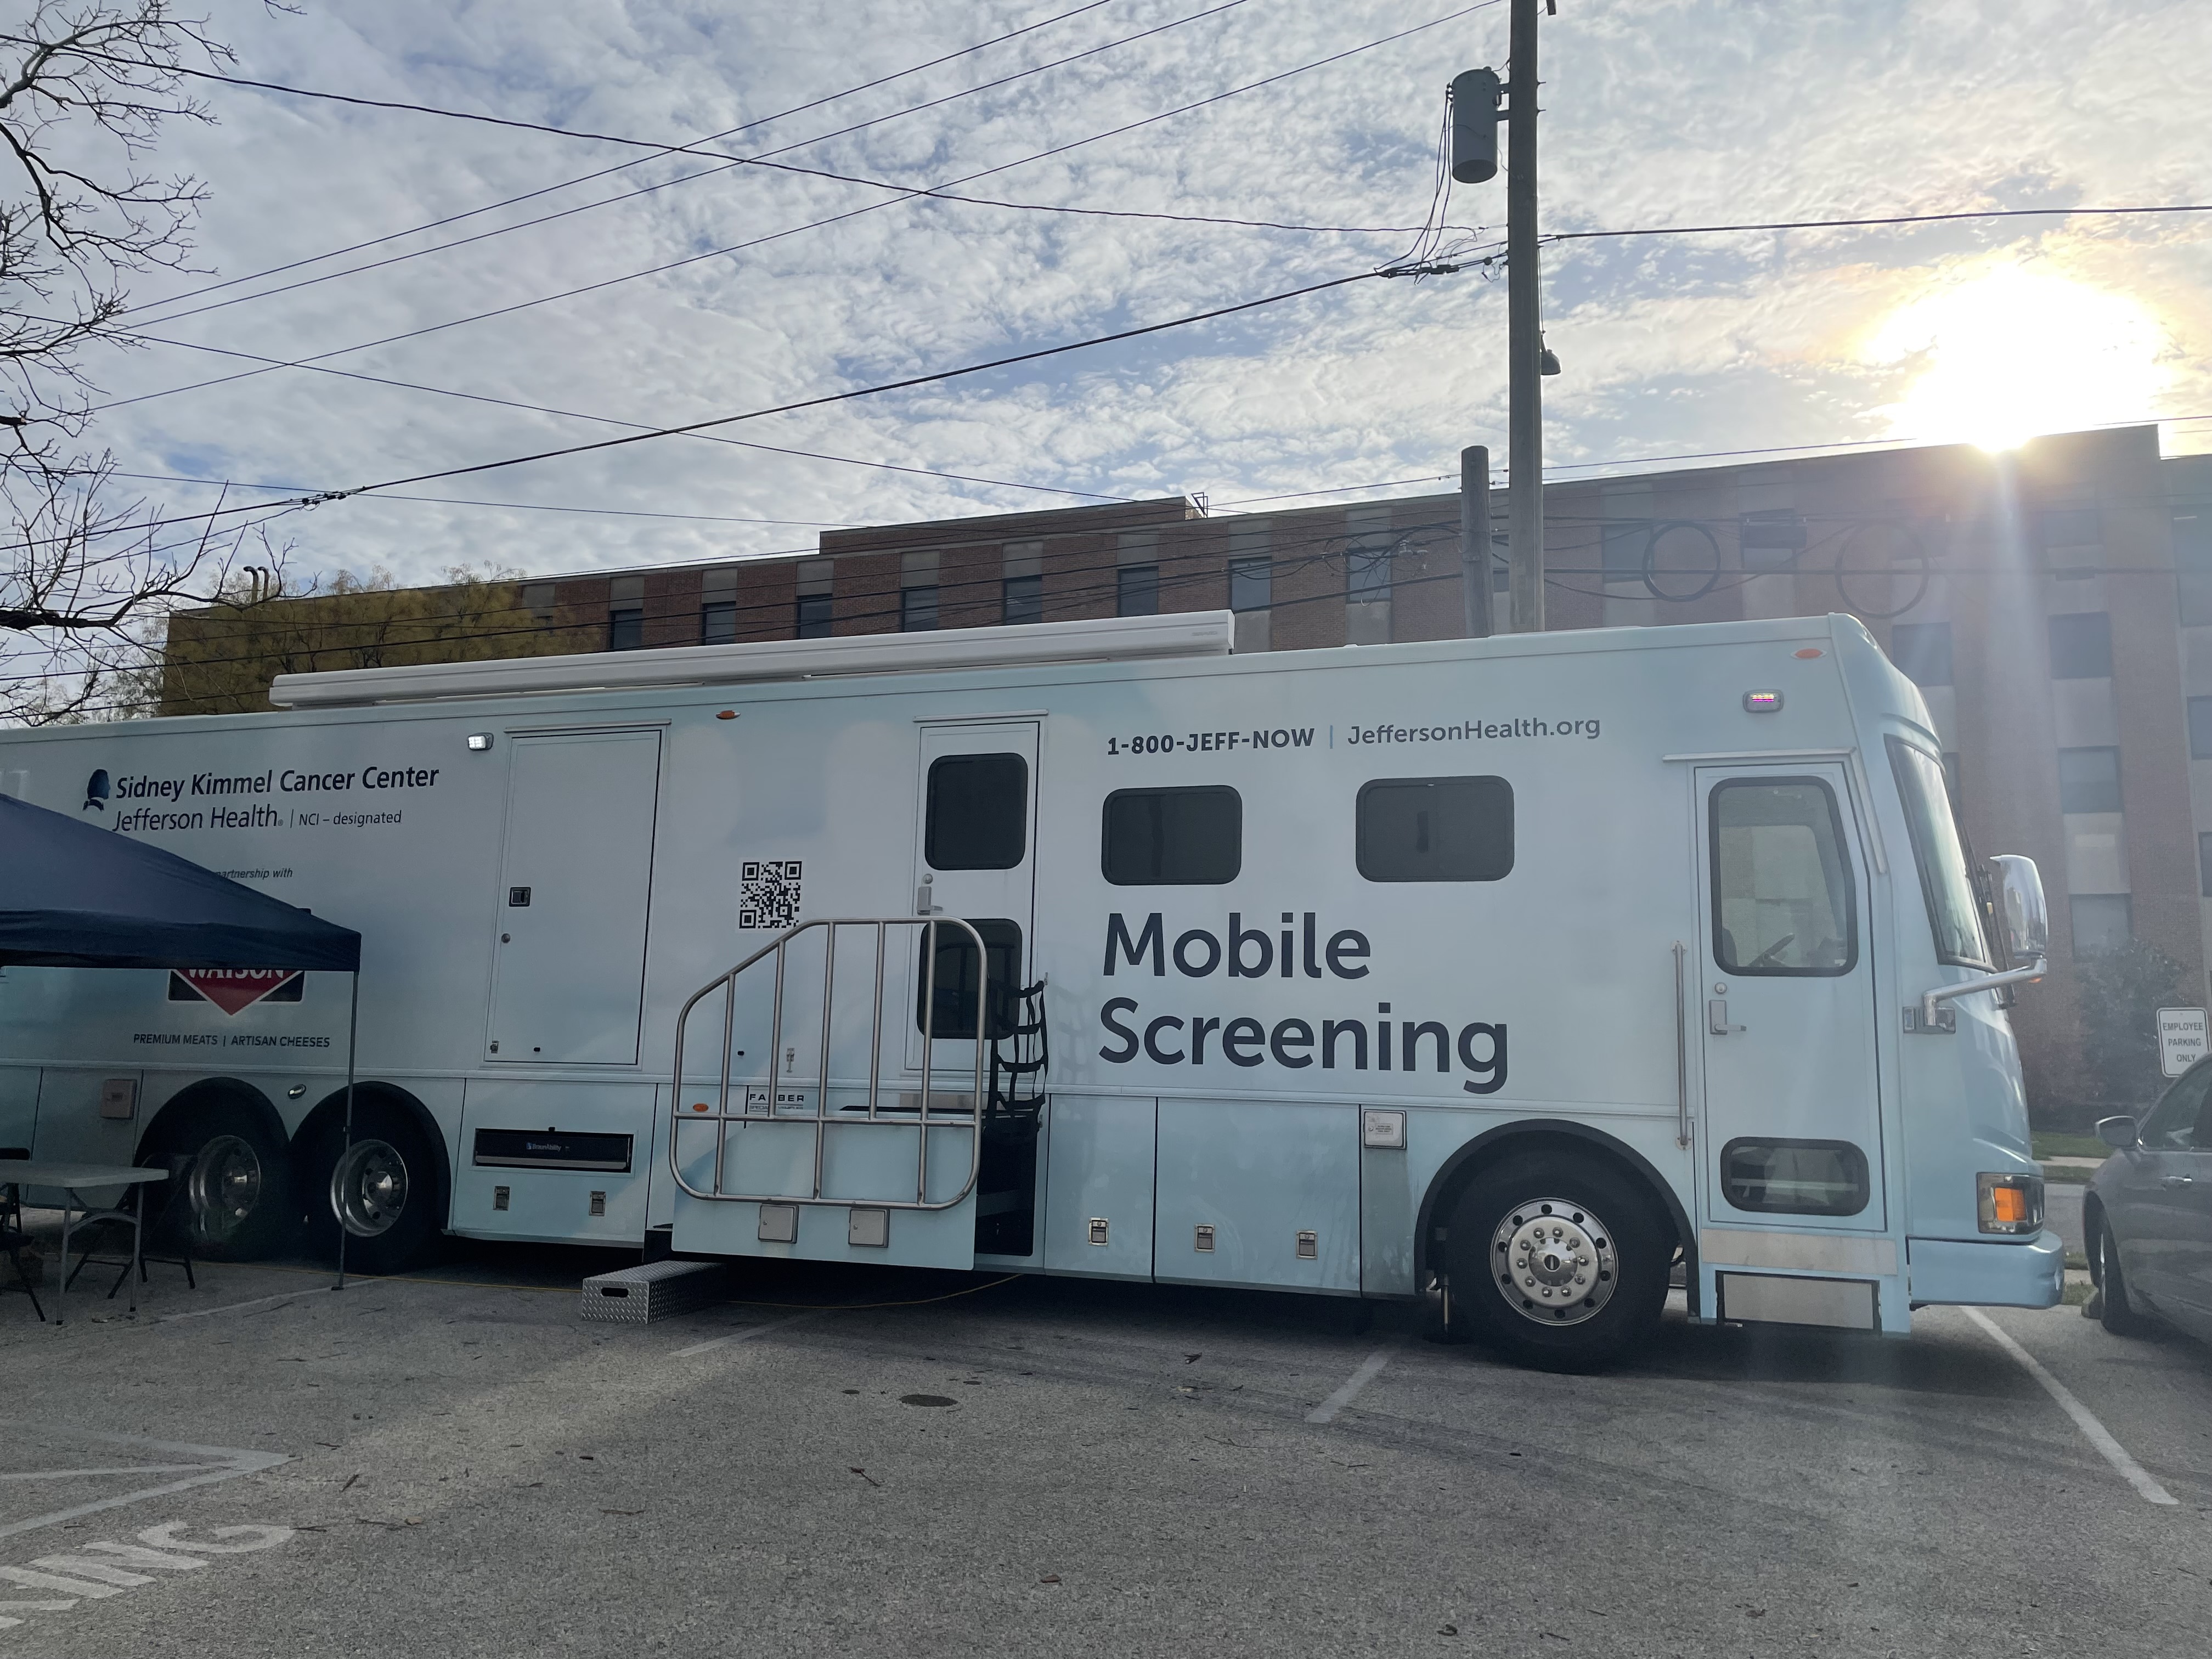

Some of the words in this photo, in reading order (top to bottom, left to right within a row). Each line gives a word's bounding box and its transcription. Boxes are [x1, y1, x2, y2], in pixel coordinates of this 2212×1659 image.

[1107, 728, 1315, 755] 1-800-JEFF-NOW
[1347, 718, 1600, 745] JeffersonHealth.org
[116, 775, 185, 803] Sidney
[191, 769, 273, 795] Kimmel
[280, 770, 356, 792] Cancer
[362, 766, 439, 789] Center
[111, 809, 203, 832] Jefferson
[299, 812, 320, 826] NCI
[332, 810, 402, 827] designated
[273, 867, 294, 878] with
[1103, 912, 1372, 980] Mobile
[2162, 1022, 2204, 1031] EMPLOYEE
[133, 1033, 181, 1045] PREMIUM
[183, 1034, 218, 1046] MEATS
[230, 1035, 277, 1047] ARTISAN
[279, 1036, 330, 1048] CHEESES
[1098, 996, 1509, 1094] Screening
[2168, 1038, 2202, 1047] PARKING
[2176, 1054, 2196, 1063] ONLY
[749, 1093, 804, 1102] FABER
